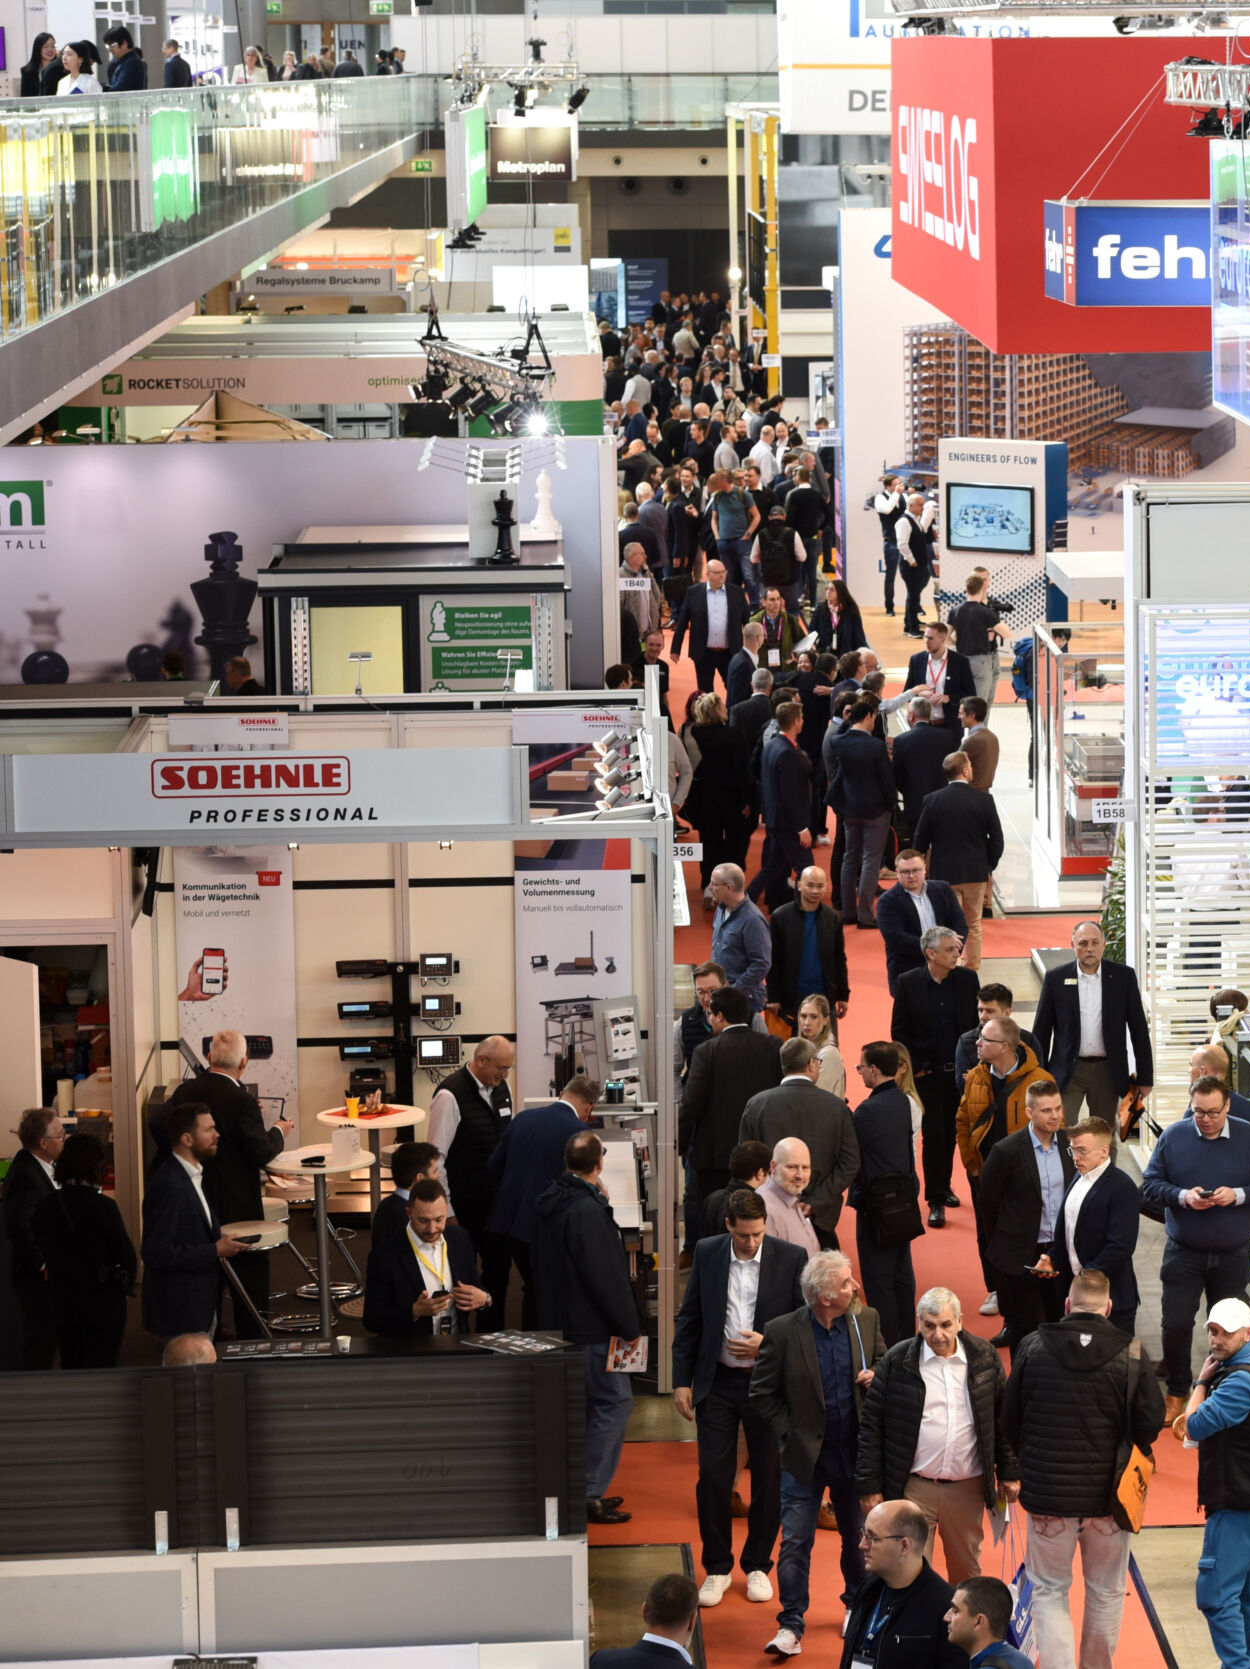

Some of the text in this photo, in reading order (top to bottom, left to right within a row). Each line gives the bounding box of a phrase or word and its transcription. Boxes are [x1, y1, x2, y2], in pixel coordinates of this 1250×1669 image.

[848, 90, 892, 112] DE
[497, 161, 566, 175] Metroplan
[1044, 227, 1064, 274] fehr
[1092, 234, 1213, 280] feh
[256, 276, 381, 286] Regalsysteme Bruckamp
[948, 452, 1038, 465] ENGINEERS OF FLOW
[624, 579, 645, 588] 1B40
[160, 763, 342, 790] SOEHNLE
[189, 807, 379, 824] PROFESSIONAL
[1096, 808, 1126, 818] 1B58
[262, 875, 276, 883] NEU
[522, 878, 563, 886] Gewichts-
[182, 882, 247, 891] Kommunikation
[182, 892, 261, 902] in der Wägetechnik
[522, 888, 595, 898] Volumenmessung
[523, 903, 623, 912] Manuell bis vollautomatisch
[183, 909, 251, 918] Mobil und vernetzt
